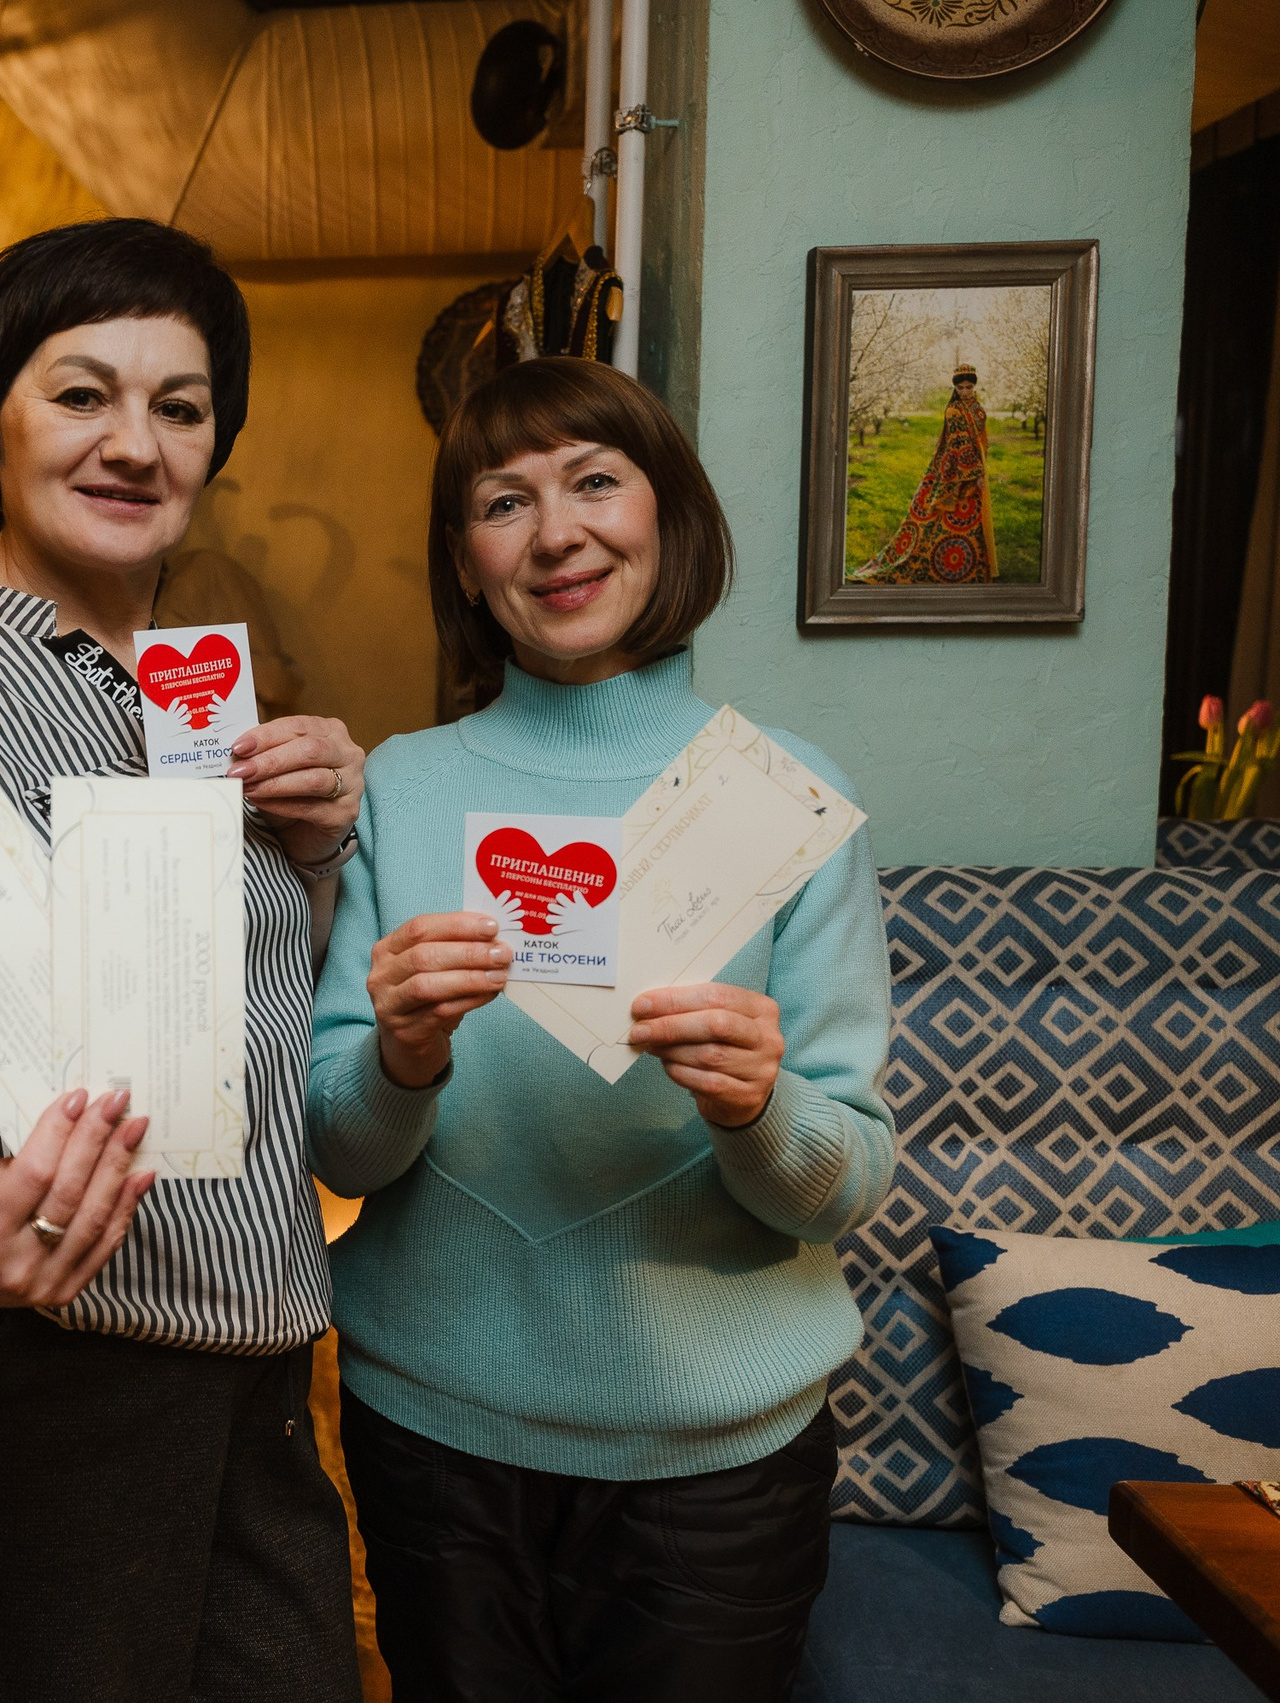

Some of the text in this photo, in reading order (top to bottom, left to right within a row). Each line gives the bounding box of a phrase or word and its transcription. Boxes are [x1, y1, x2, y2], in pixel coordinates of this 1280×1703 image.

[149, 657, 233, 684] ПРИГЛАШЕНИЕ
[64, 643, 144, 719] But the
[165, 678, 192, 690] ПЕРСОНЫ
[192, 672, 226, 684] БЕСПЛАТНО
[193, 738, 220, 748] КАТОК
[160, 751, 203, 765] СЕРДЦЕ
[490, 854, 604, 888] ПРИГЛАШЕНИЕ
[505, 872, 543, 886] ПЕРСОНЫ
[524, 940, 559, 950] КАТОК
